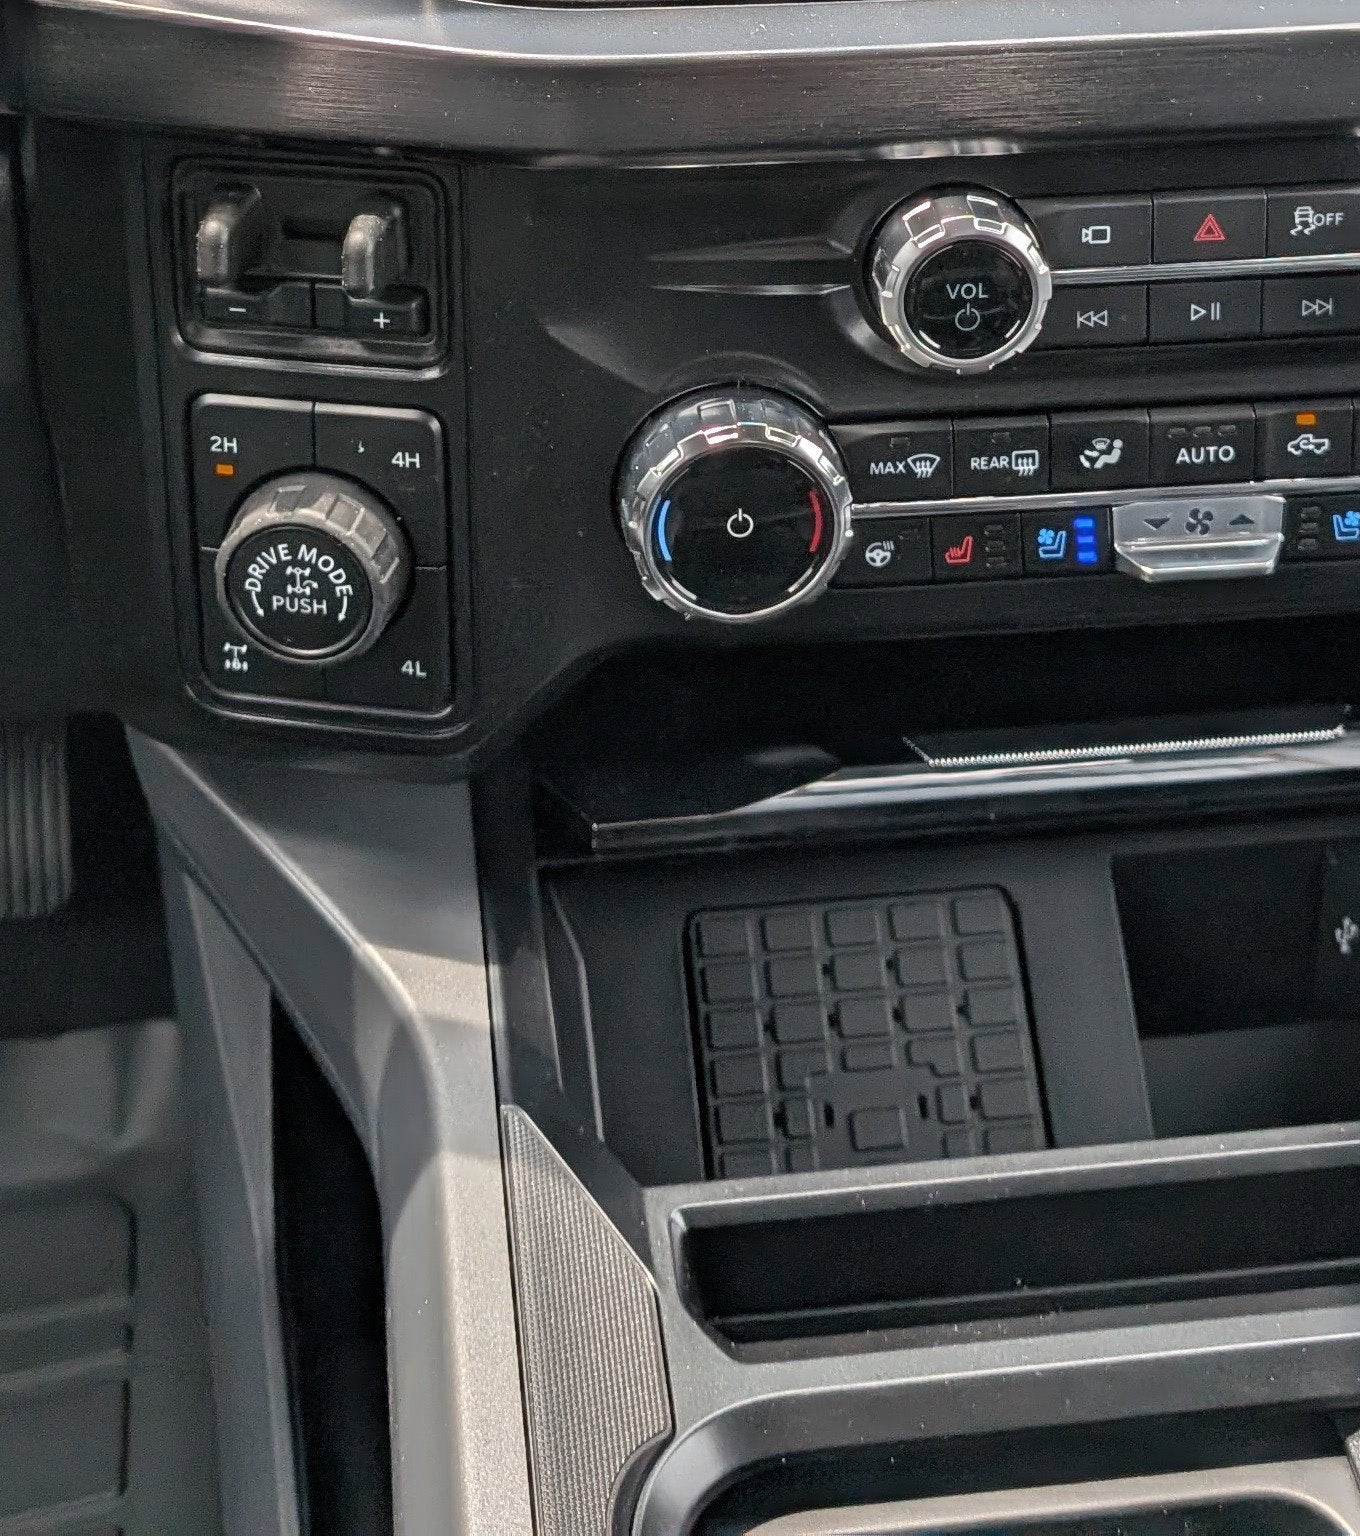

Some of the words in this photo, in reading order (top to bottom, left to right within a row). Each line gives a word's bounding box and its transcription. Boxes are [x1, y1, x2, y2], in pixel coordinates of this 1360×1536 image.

[1313, 211, 1344, 229] OFF
[946, 283, 988, 299] VOL
[211, 436, 237, 453] 2H
[392, 452, 420, 468] 4H
[971, 456, 1009, 469] REAR
[1177, 446, 1234, 463] AUTO
[870, 462, 905, 474] MAX
[245, 543, 293, 593] DRIVE
[298, 544, 354, 596] MODE
[272, 595, 328, 615] PUSH
[402, 660, 426, 677] 4L
